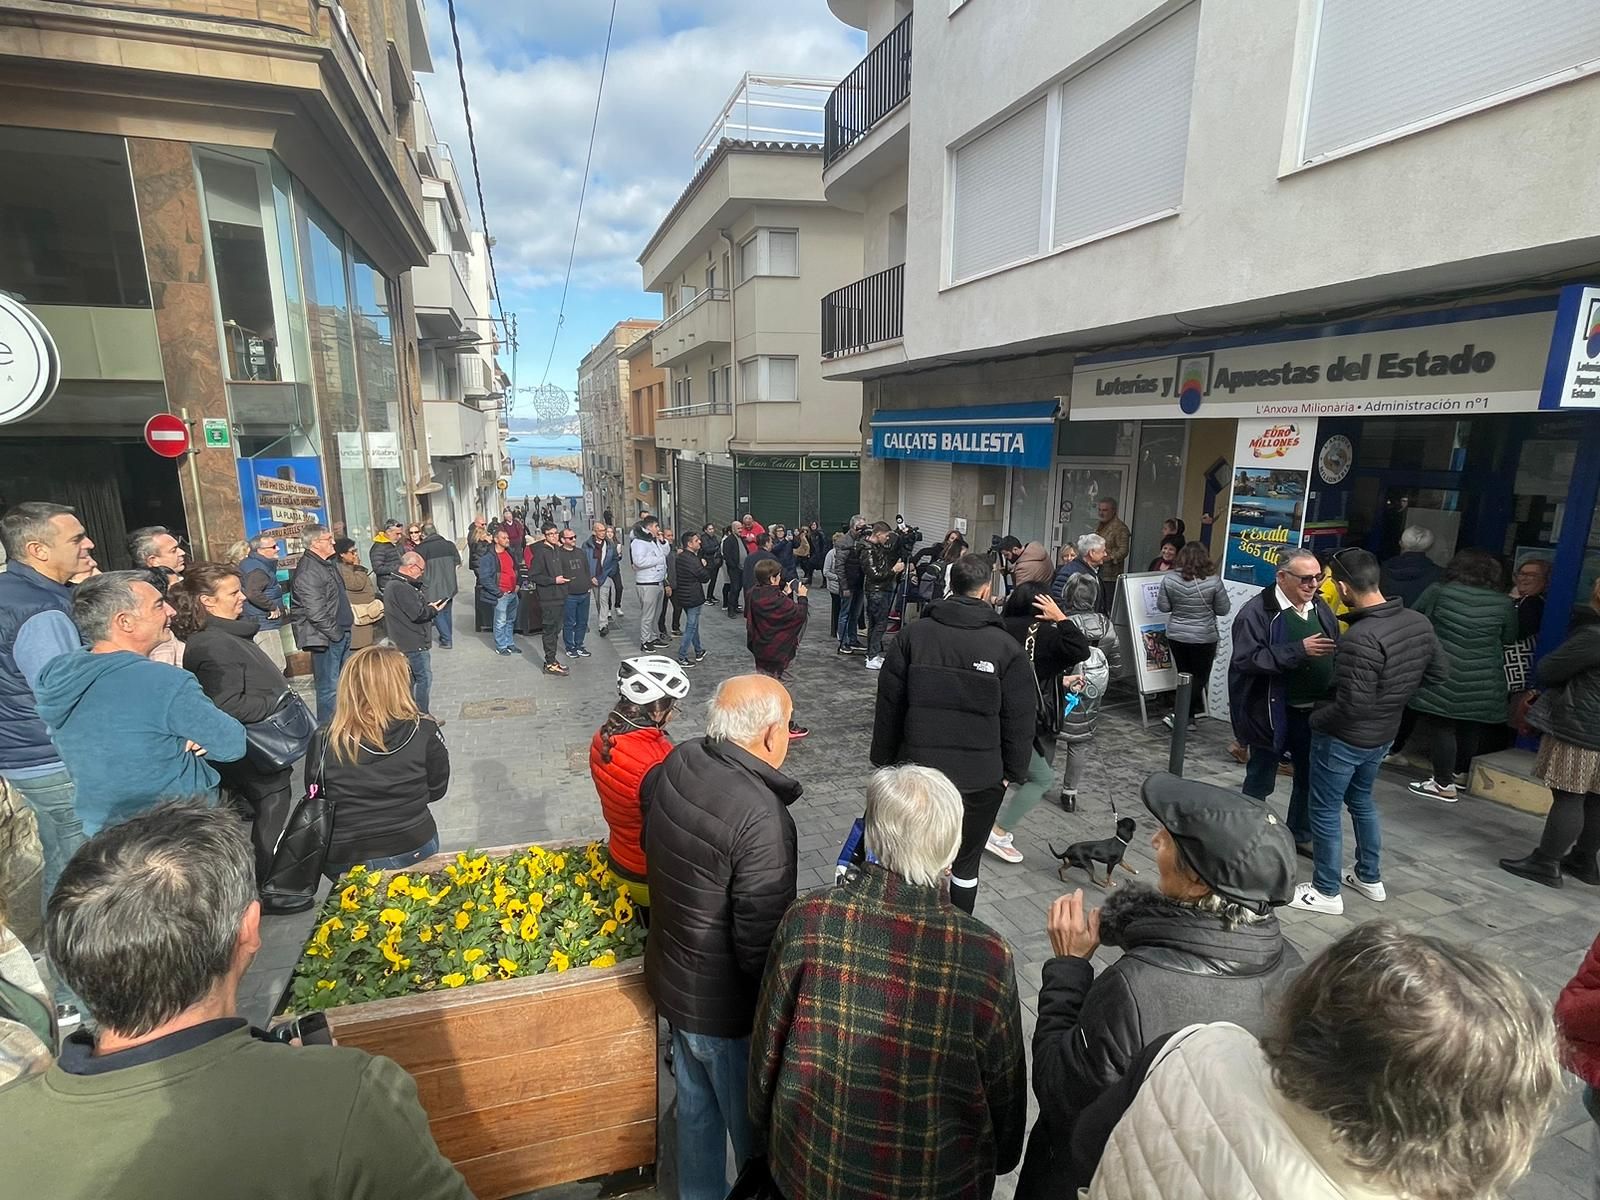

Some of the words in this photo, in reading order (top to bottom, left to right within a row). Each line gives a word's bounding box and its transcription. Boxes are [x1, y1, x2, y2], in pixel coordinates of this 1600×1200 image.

[1095, 373, 1158, 397] Loterías
[1161, 376, 1174, 398] y
[1213, 361, 1320, 394] Apuestas
[1327, 353, 1372, 382] del
[1377, 344, 1496, 380] Estado
[1256, 404, 1298, 415] L'Anxova
[1301, 403, 1355, 414] Milionària
[1364, 398, 1461, 412] Administración
[1263, 429, 1291, 438] EURO
[884, 432, 937, 454] CALÇATS
[941, 432, 1025, 454] BALLESTA
[1249, 437, 1300, 448] MILLONES
[1238, 540, 1261, 557] 365
